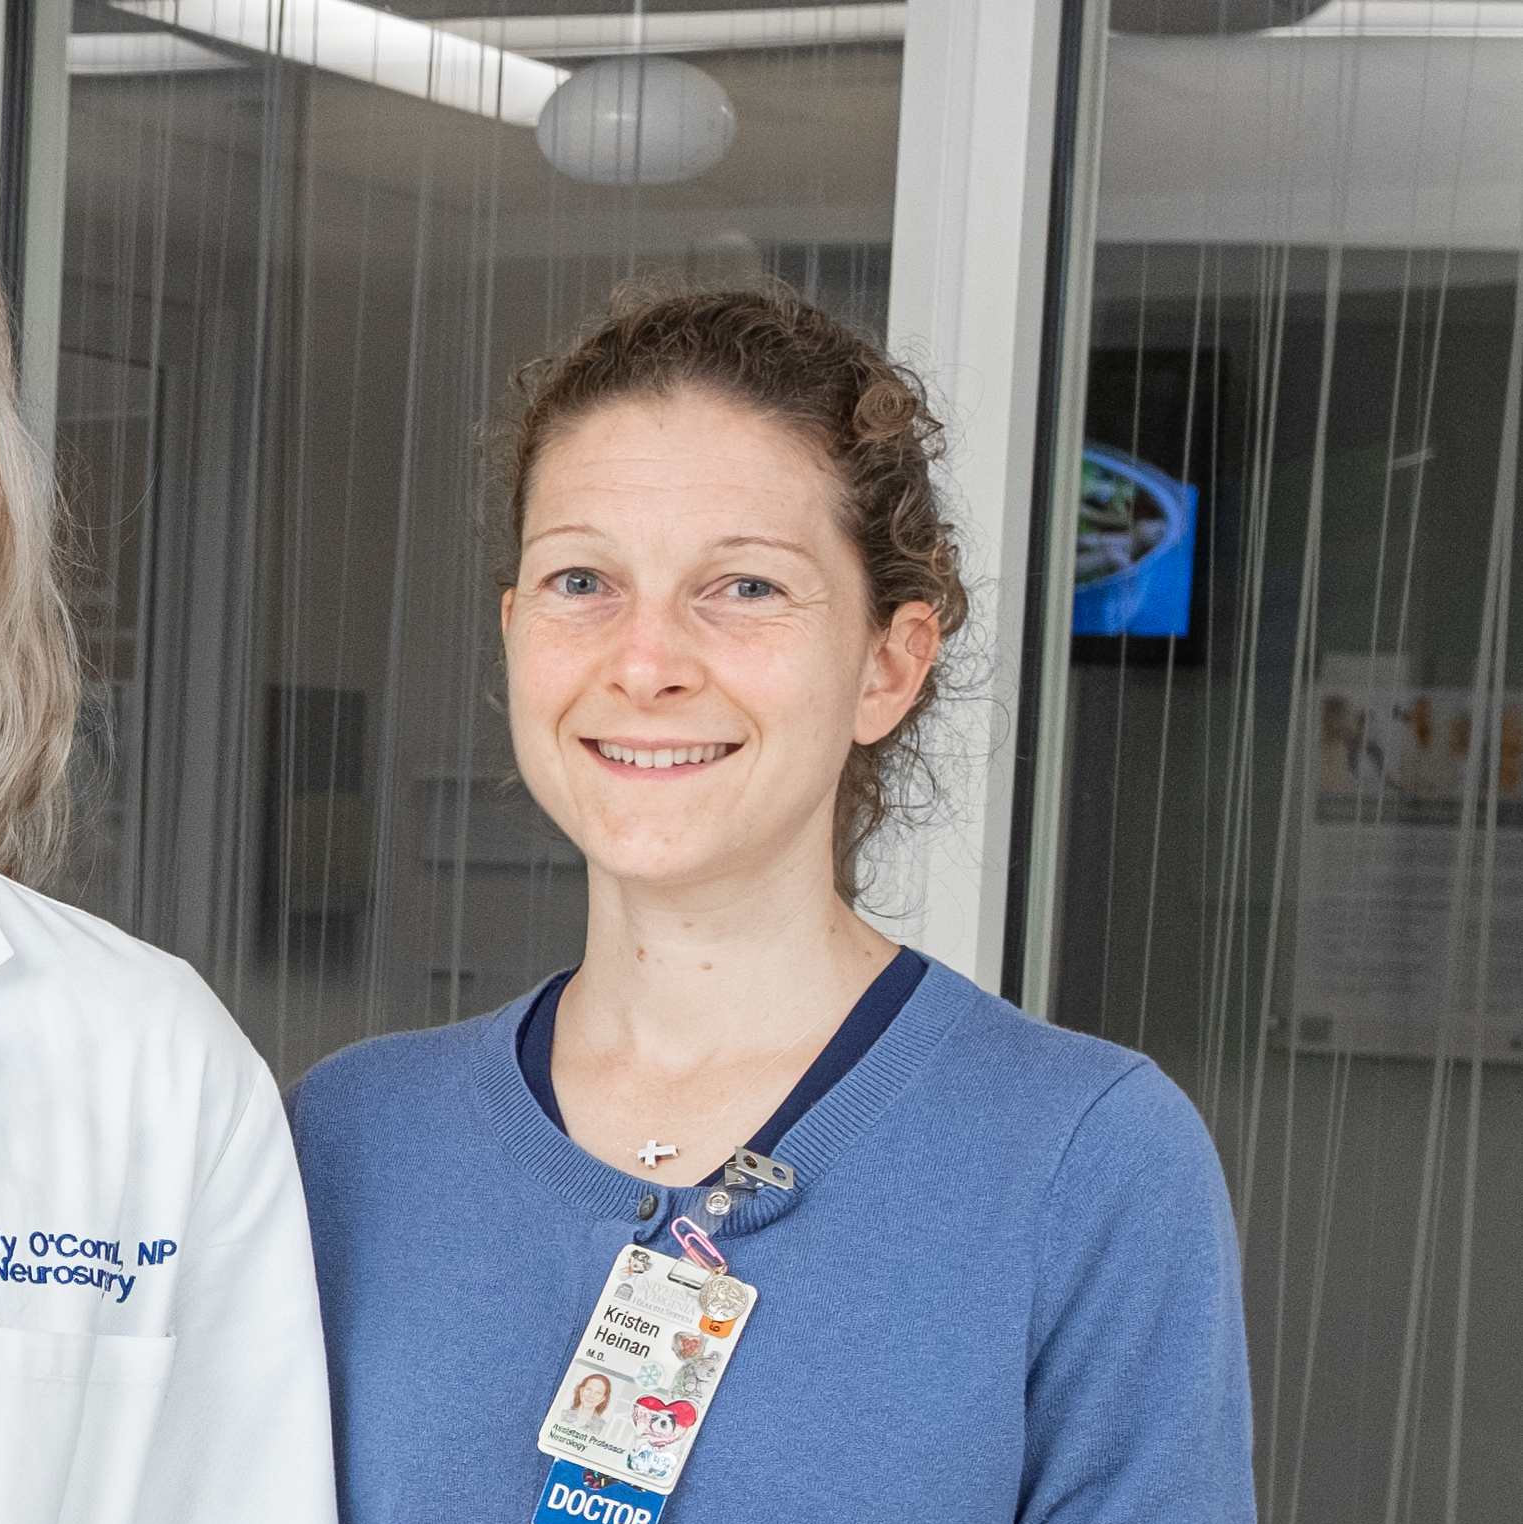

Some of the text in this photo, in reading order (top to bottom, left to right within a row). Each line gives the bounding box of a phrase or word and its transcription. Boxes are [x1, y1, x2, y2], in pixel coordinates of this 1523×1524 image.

[137, 1240, 177, 1266] NP
[604, 1305, 660, 1338] Kristen
[586, 1348, 605, 1362] M.D.
[594, 1326, 651, 1358] Heinan
